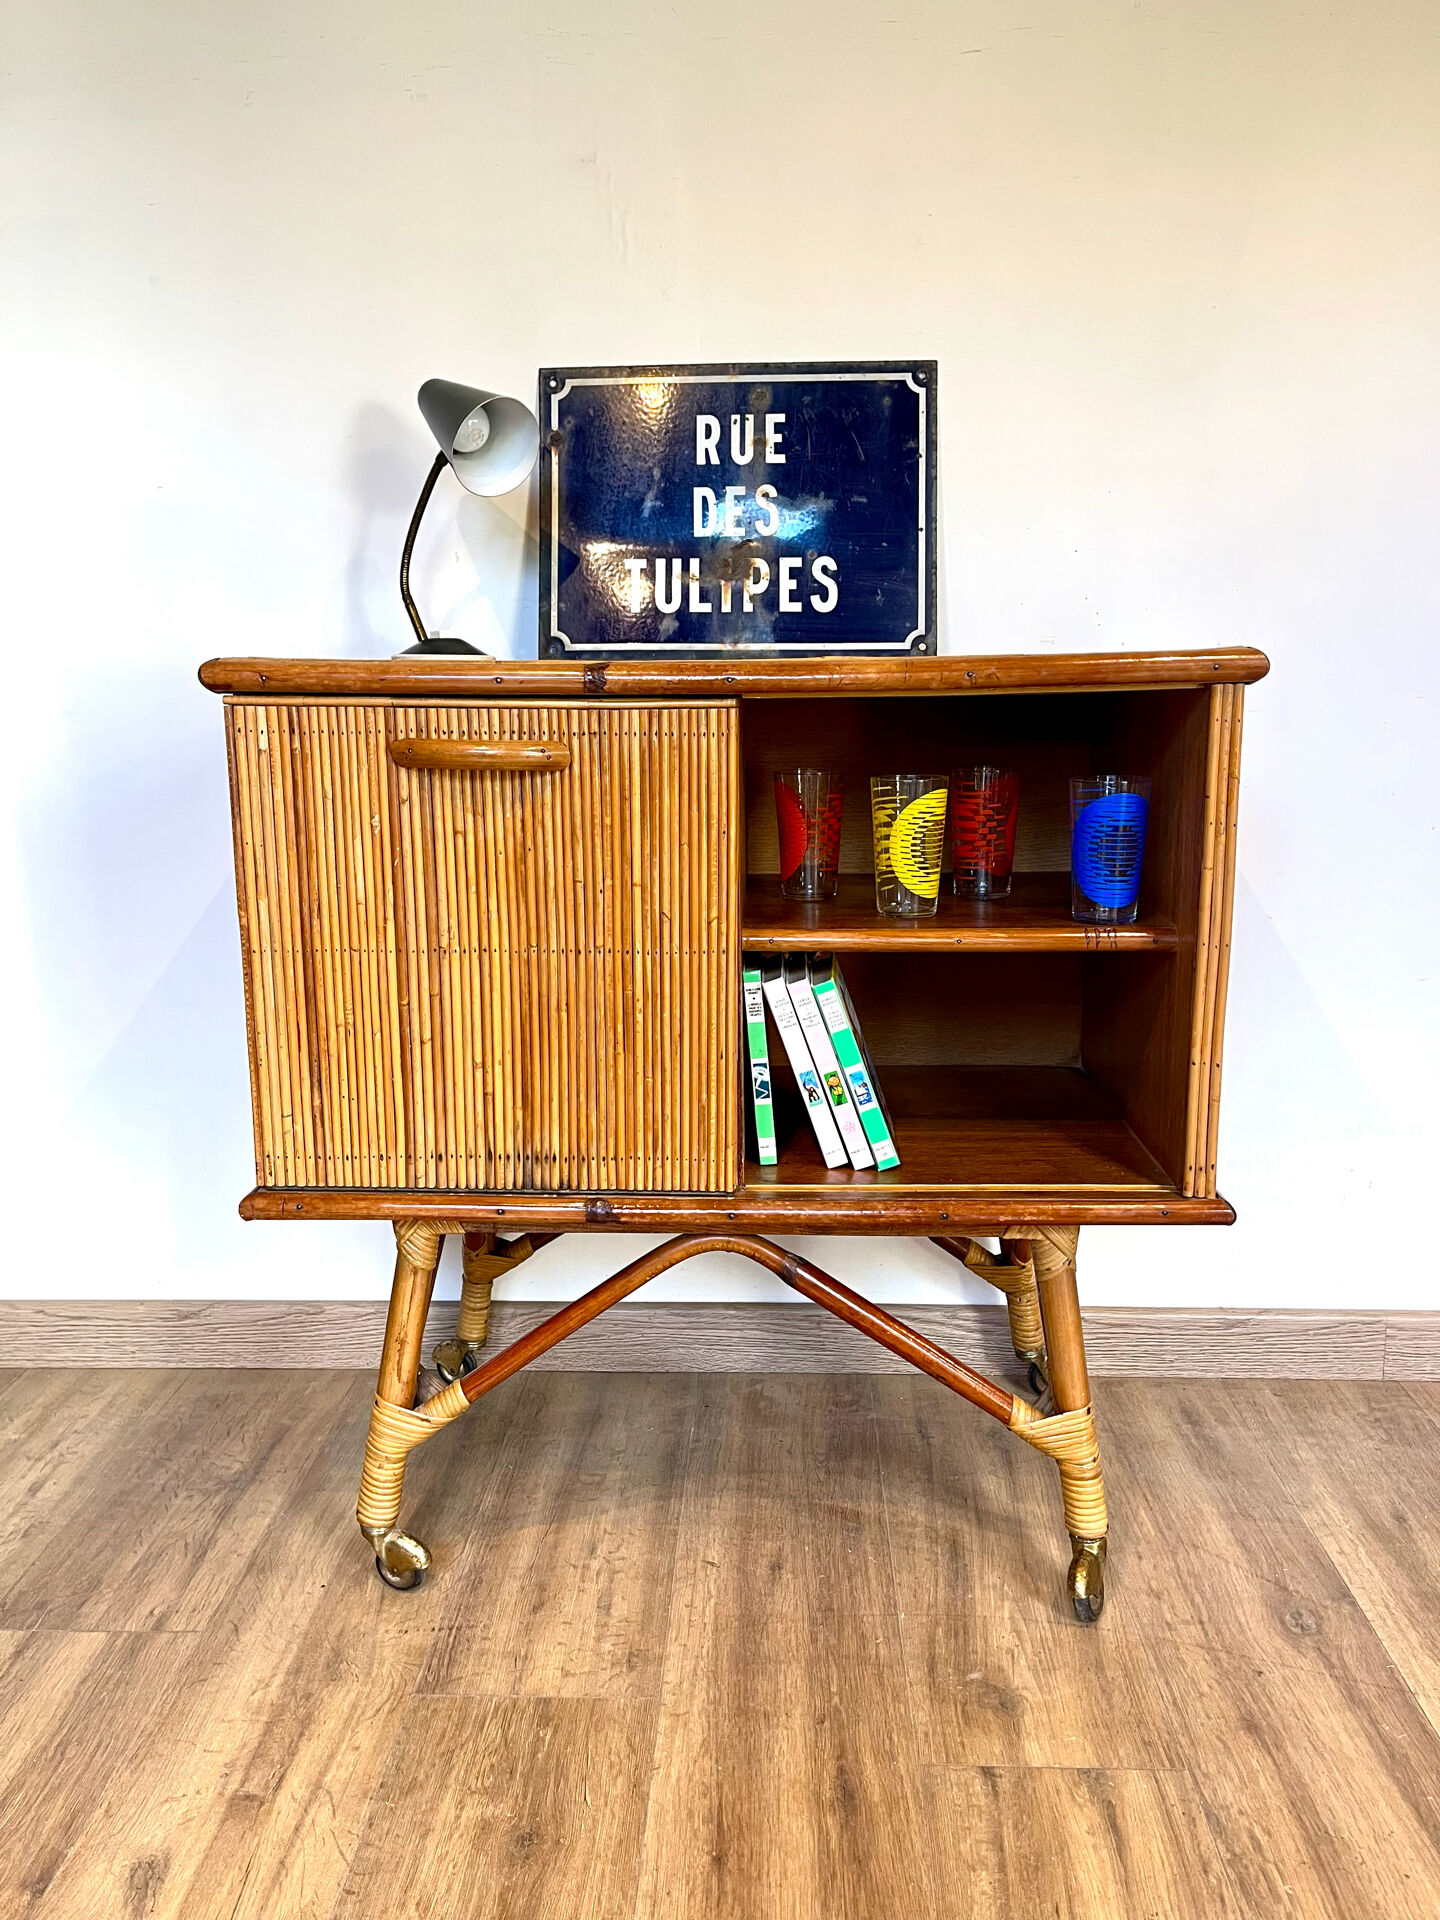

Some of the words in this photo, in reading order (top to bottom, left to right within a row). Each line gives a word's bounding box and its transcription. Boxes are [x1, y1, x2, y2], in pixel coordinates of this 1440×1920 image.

[696, 413, 786, 465] RUE
[692, 484, 778, 537] DES
[625, 556, 839, 614] TULIPES
